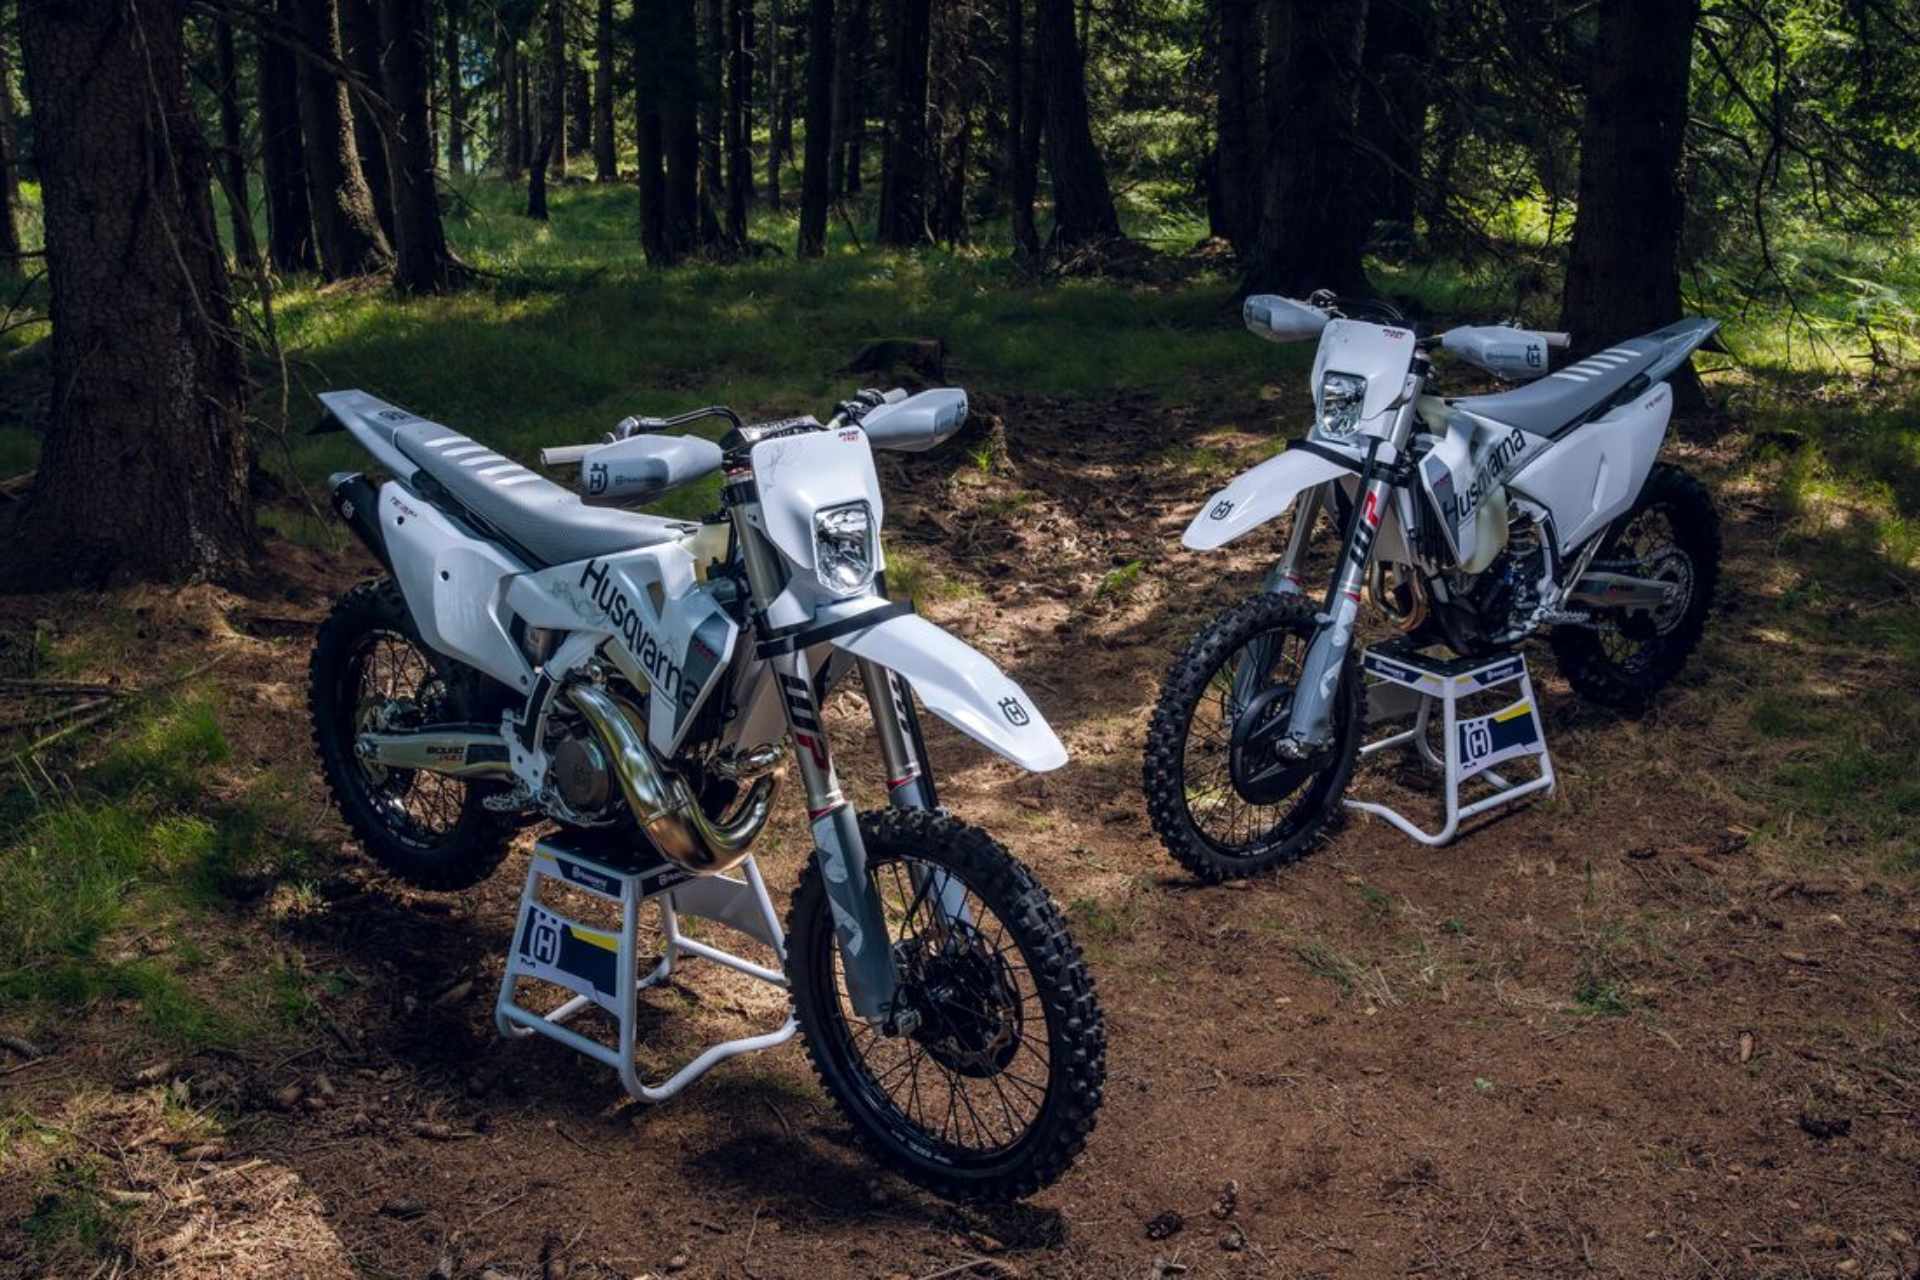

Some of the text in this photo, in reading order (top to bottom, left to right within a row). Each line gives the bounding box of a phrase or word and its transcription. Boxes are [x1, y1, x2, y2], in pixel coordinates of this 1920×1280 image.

[1443, 428, 1527, 524] Husqvarna
[578, 559, 701, 709] Husqvarna
[779, 673, 830, 771] WP
